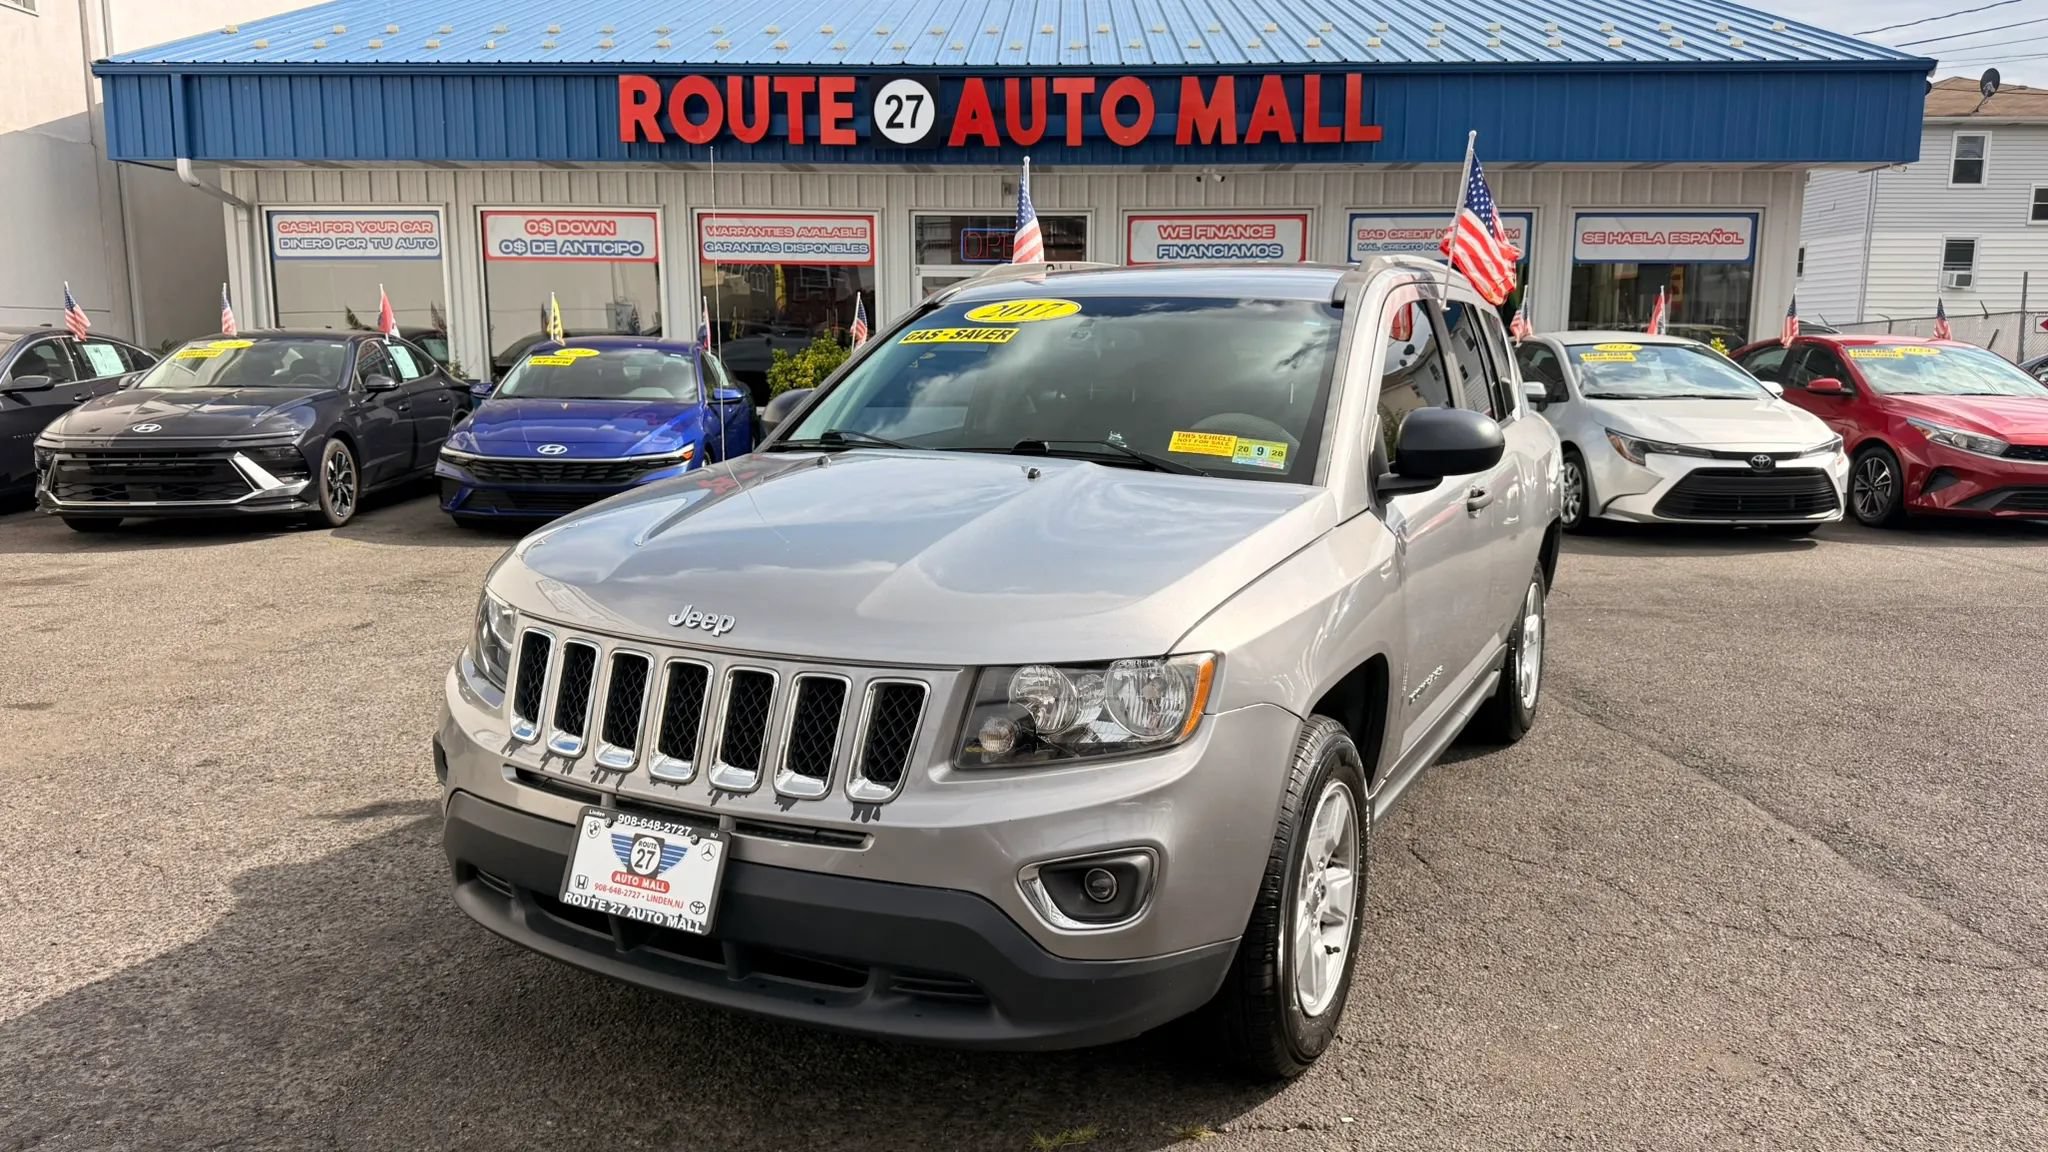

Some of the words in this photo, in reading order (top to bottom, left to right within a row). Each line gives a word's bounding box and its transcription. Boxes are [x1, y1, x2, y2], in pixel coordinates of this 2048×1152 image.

[618, 74, 857, 145] ROUTE
[885, 94, 924, 129] 27
[947, 75, 1156, 147] AUTO
[1175, 73, 1382, 145] MALL
[278, 221, 321, 233] CASH
[323, 221, 353, 234] FOR
[357, 221, 398, 234] YOUR
[400, 221, 433, 233] CAR
[556, 220, 616, 235] DOWN
[706, 226, 794, 237] WARRANTIES
[797, 227, 867, 238] AVAILABLE
[1158, 224, 1192, 239] WE
[1194, 224, 1275, 239] FINANCE
[1358, 229, 1387, 240] BAD
[1389, 229, 1434, 239] CREDIT
[279, 238, 333, 249] DINERO
[336, 238, 367, 249] POR
[370, 238, 392, 249] TU
[395, 238, 438, 249] AUTO
[1582, 232, 1605, 244] SE
[1608, 232, 1665, 244] HABLA
[1668, 228, 1744, 245] ESPAÑOL
[530, 240, 557, 255] DE
[559, 240, 644, 256] ANTICIPO
[704, 241, 781, 253] GARANTIAS
[783, 243, 869, 254] DISPONIBLES
[965, 232, 1015, 258] OPE
[1157, 244, 1283, 259] FINANCIAMOS
[1357, 242, 1380, 251] MAL
[979, 303, 1066, 318] 2017
[1198, 434, 1233, 442] VEHICLE
[1256, 446, 1264, 456] 9
[668, 604, 736, 637] Jeep
[617, 814, 692, 837] 908-648-2727
[638, 840, 657, 850] ROUTE
[634, 849, 656, 870] 27
[614, 873, 639, 886] AUTO
[641, 878, 667, 892] MALL
[594, 883, 641, 900] 908-648-2727
[564, 892, 607, 911] ROUTE
[609, 903, 626, 915] 27
[627, 908, 664, 925] AUTO
[666, 915, 703, 934] MALL
